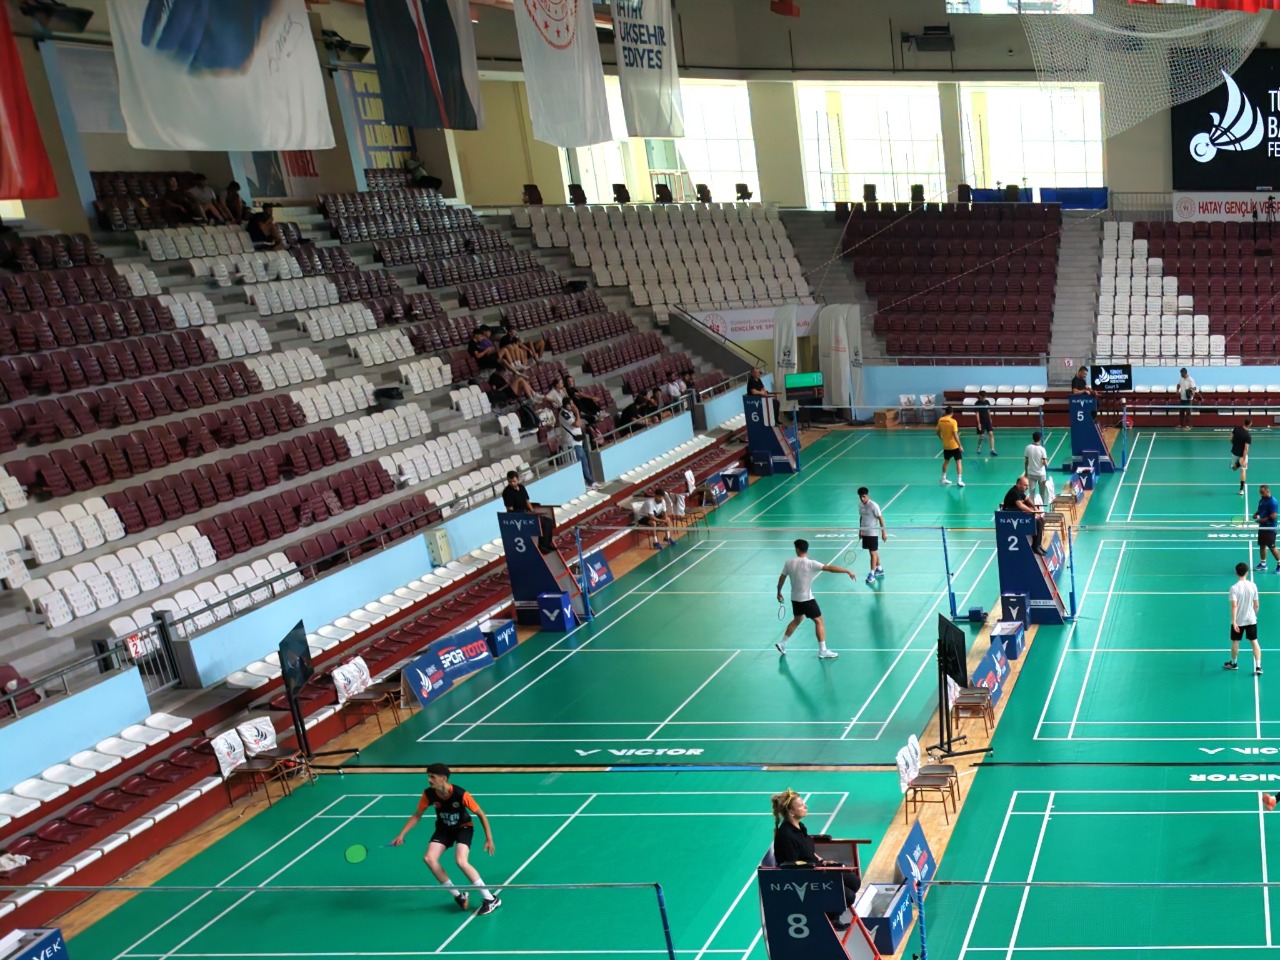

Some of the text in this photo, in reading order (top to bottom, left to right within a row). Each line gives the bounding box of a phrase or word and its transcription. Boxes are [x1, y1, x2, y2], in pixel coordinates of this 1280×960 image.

[1198, 202, 1222, 214] HATAY
[751, 412, 760, 422] 6
[1077, 411, 1084, 422] 5
[503, 519, 535, 531] NAVEK
[1000, 518, 1031, 530] NAVEK
[514, 537, 526, 552] 3
[1007, 536, 1019, 551] 2
[608, 748, 705, 756] VICTOR
[770, 882, 832, 903] NAVEK
[787, 913, 810, 938] 8
